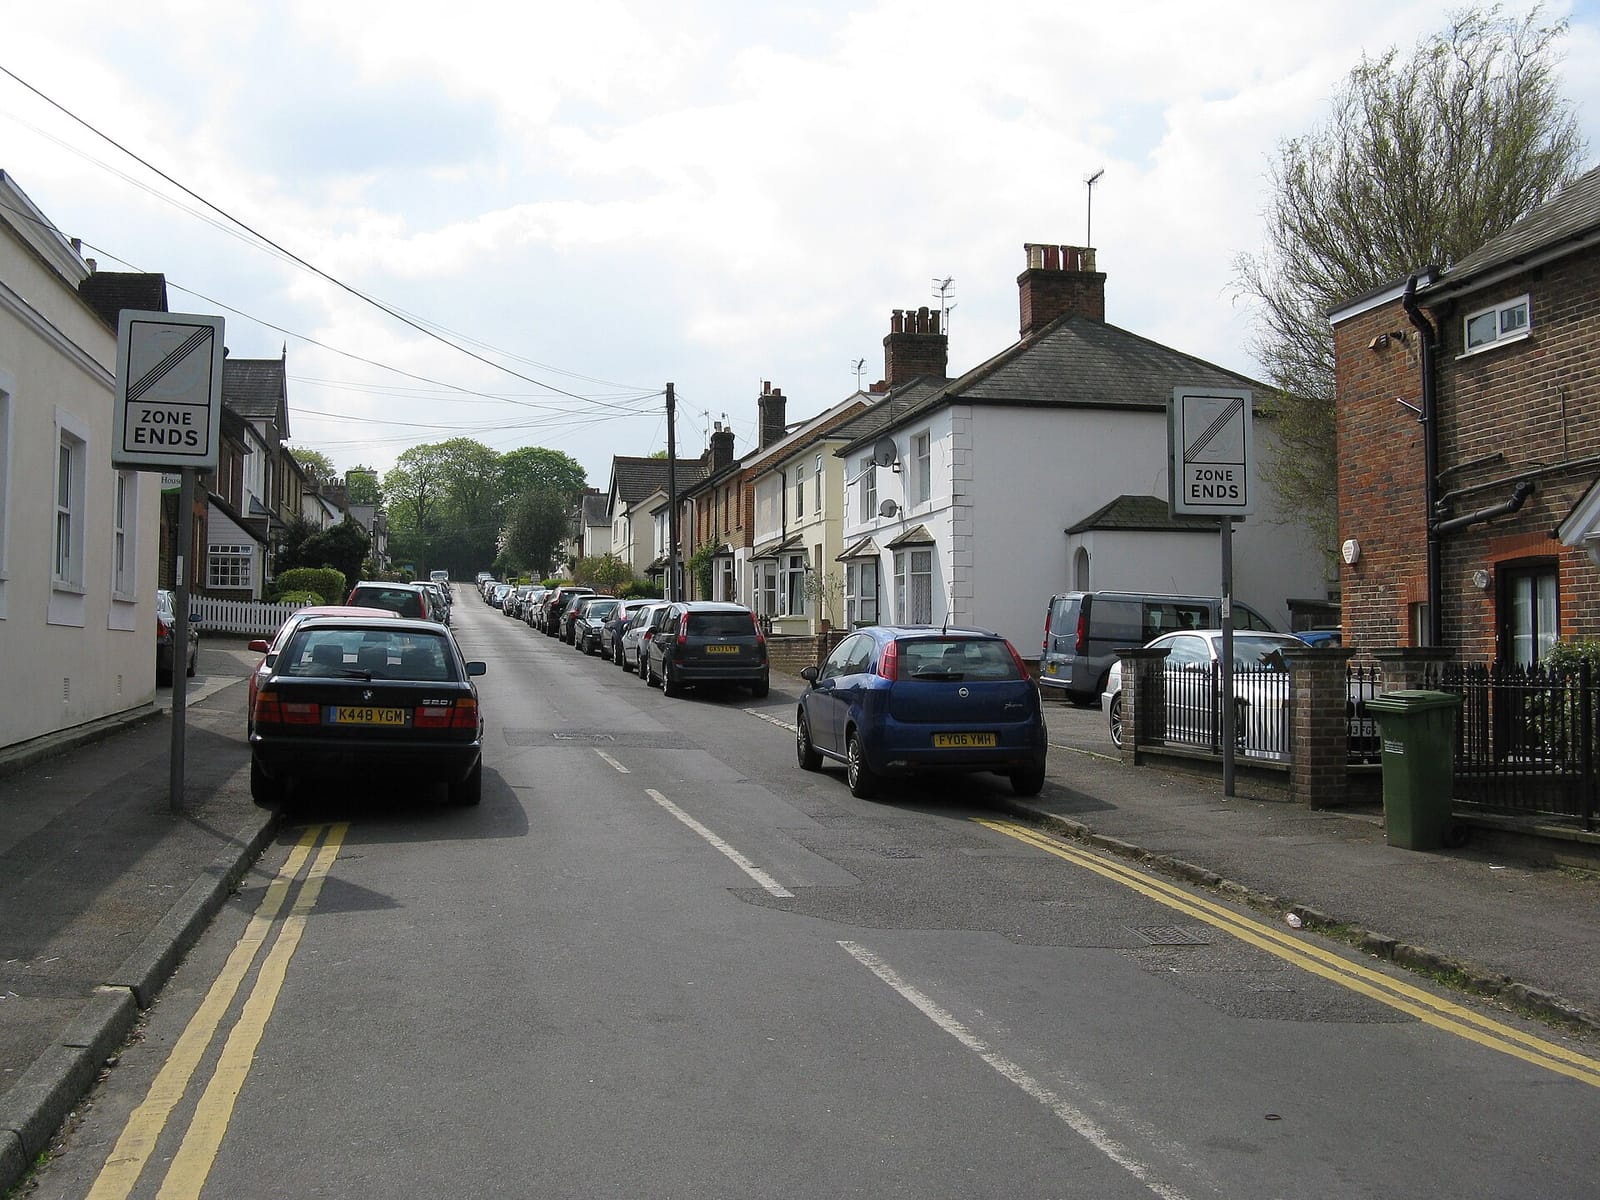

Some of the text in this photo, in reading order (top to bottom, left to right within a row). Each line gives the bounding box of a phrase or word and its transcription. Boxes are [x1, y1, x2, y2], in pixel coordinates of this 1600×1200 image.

[141, 410, 192, 425] ZONE
[134, 427, 198, 446] ENDS
[1195, 470, 1233, 481] ZONE
[1191, 484, 1239, 498] ENDS
[338, 708, 402, 722] K448 YGM
[939, 734, 991, 745] FY06 YMH
